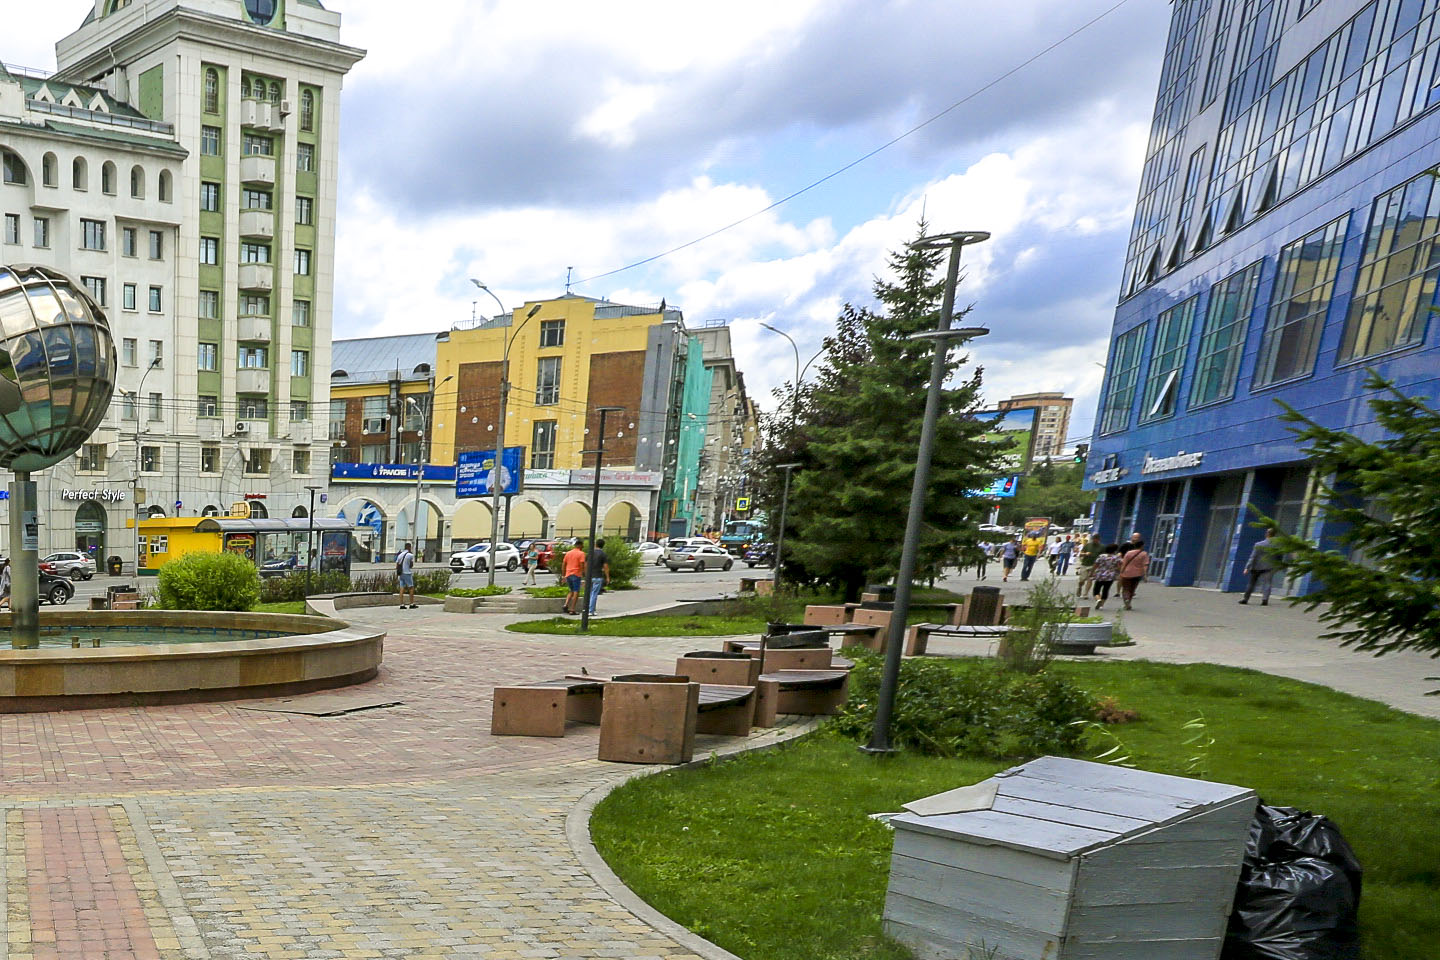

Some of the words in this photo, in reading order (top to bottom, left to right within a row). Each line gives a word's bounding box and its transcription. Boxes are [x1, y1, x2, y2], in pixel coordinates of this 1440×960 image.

[379, 468, 407, 476] УРАЛСИБ
[62, 488, 98, 500] Perfect
[101, 488, 126, 503] Style
